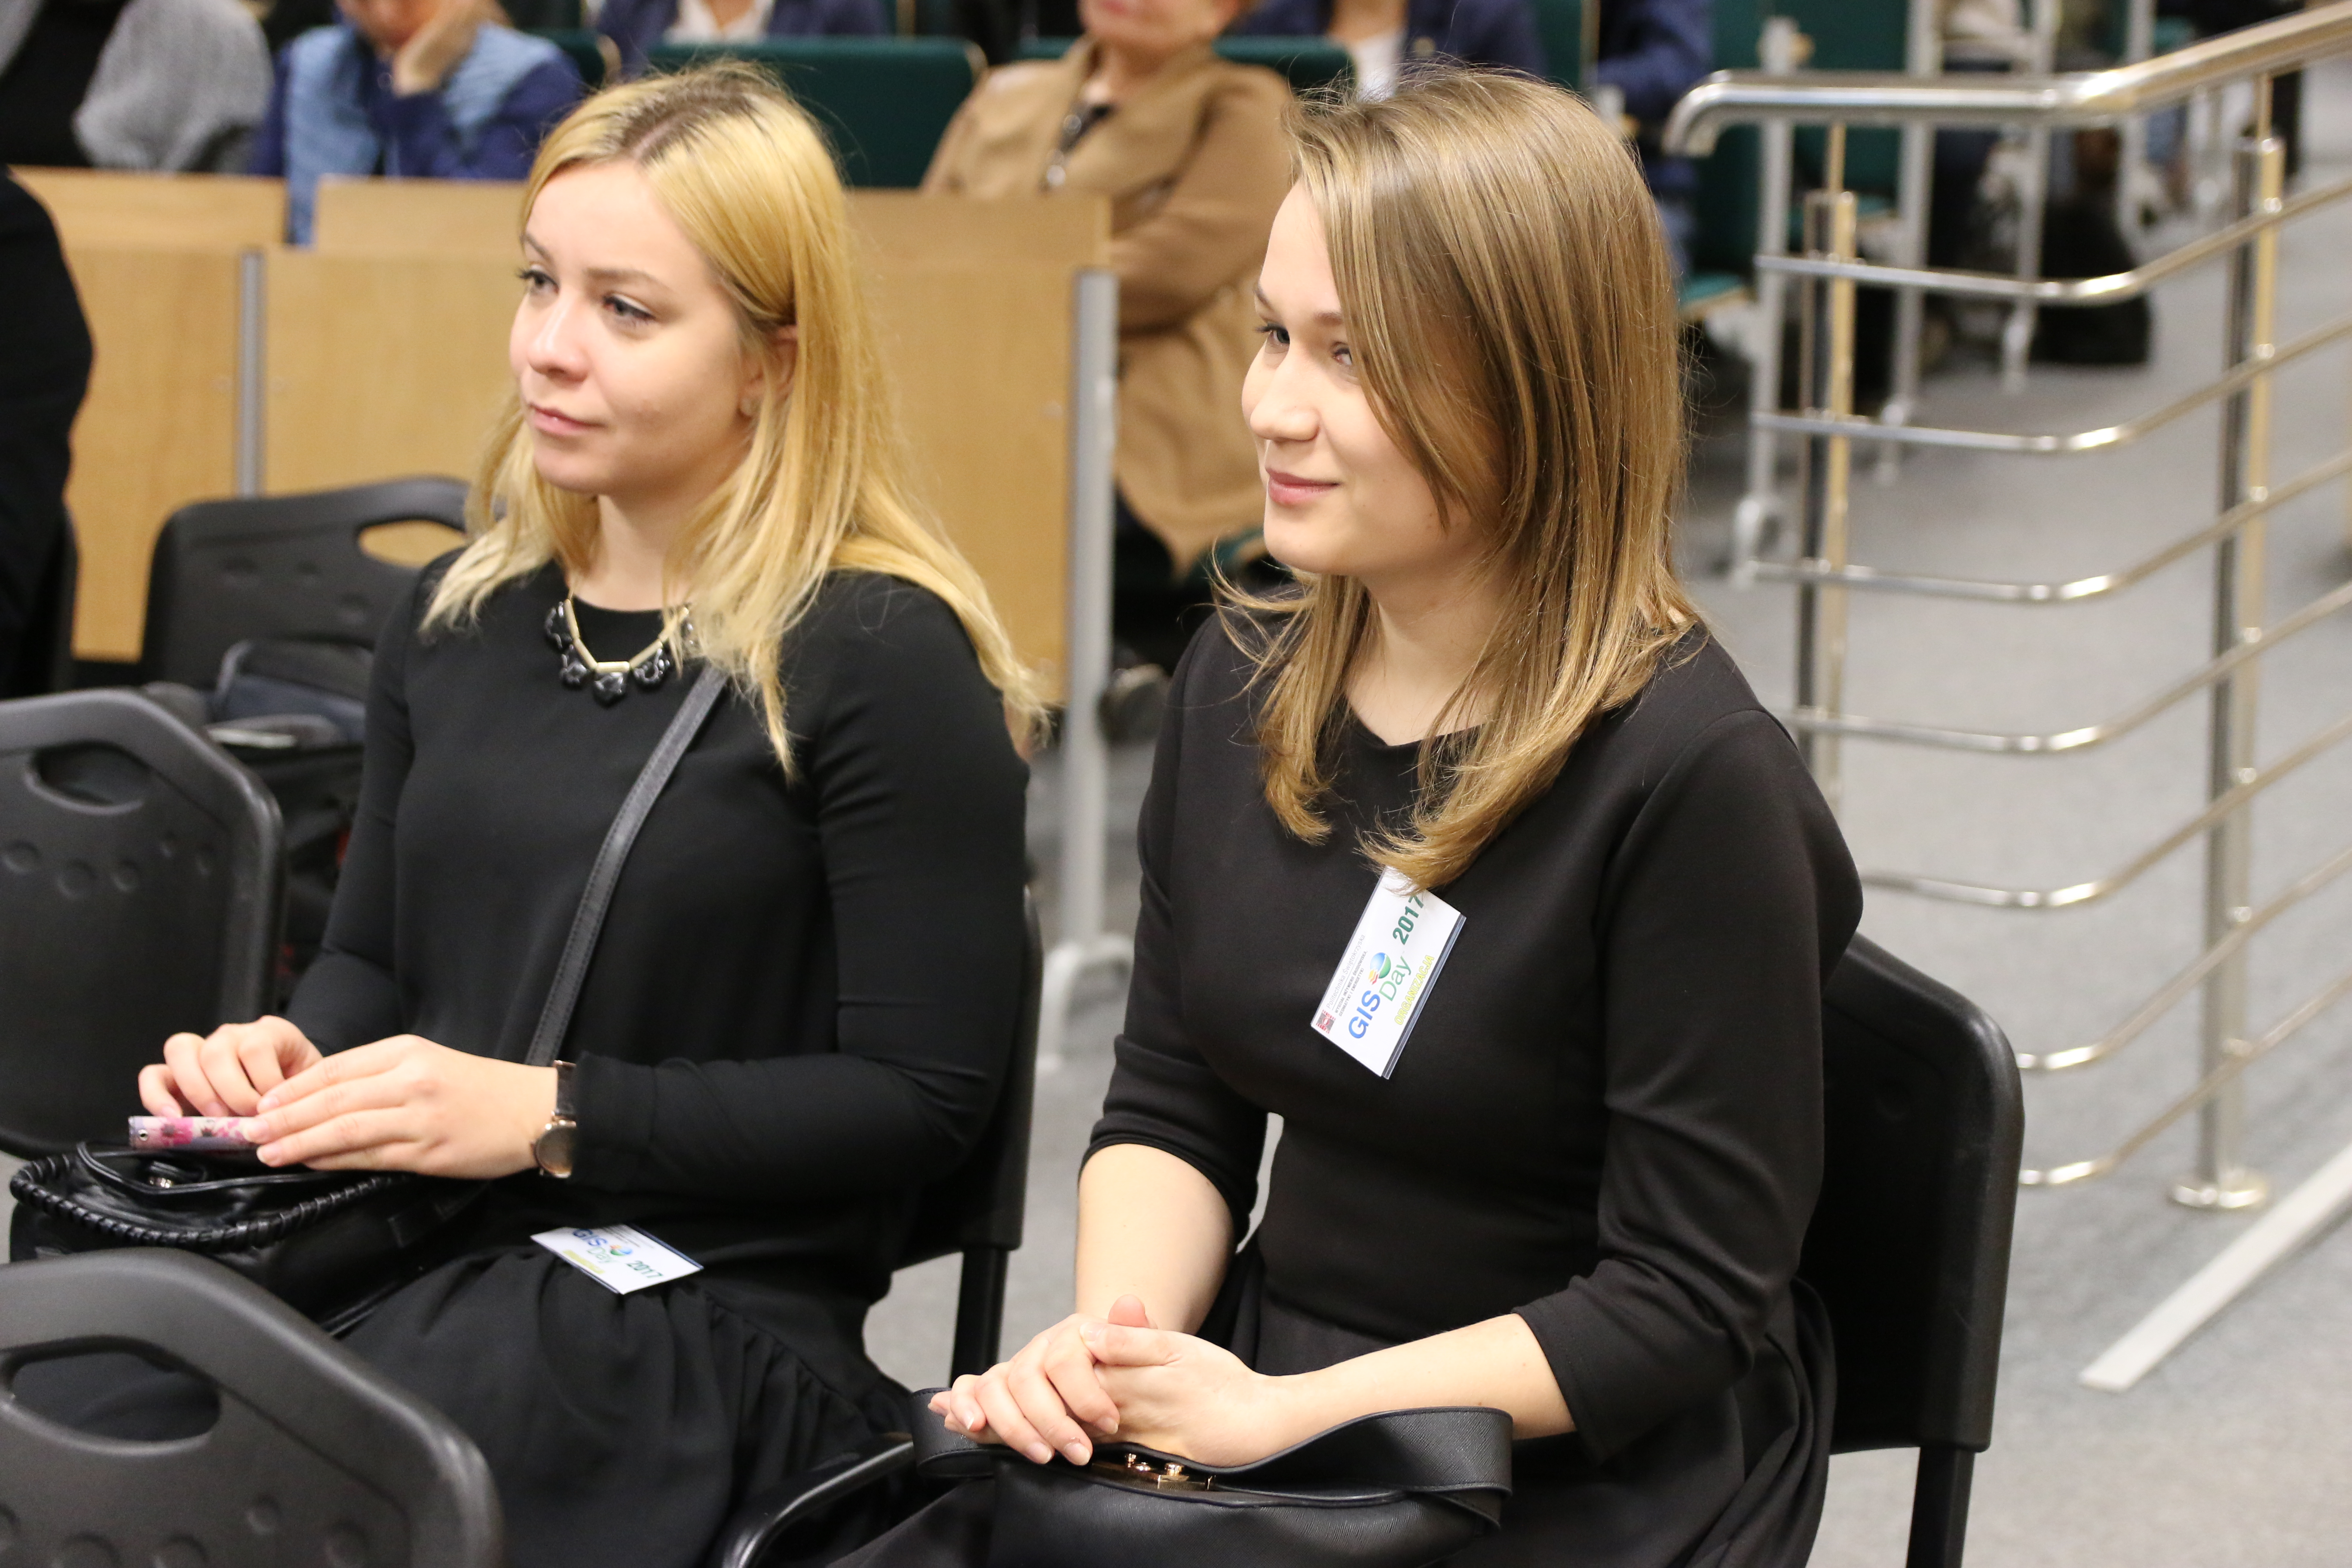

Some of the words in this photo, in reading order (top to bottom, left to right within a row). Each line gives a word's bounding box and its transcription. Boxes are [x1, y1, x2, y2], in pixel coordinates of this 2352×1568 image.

[1393, 894, 1424, 945] 2017
[1326, 975, 1346, 1009] Politechnika
[1342, 934, 1366, 975] Świętokrzyska
[1338, 995, 1351, 1017] GEOMATYKI
[1351, 968, 1364, 992] ENERGETYKI
[1379, 956, 1412, 1001] Day
[1394, 955, 1435, 1025] ORGANIZACJA
[1348, 990, 1381, 1039] GIS
[573, 1229, 608, 1246] GIS
[626, 1260, 663, 1278] 2017
